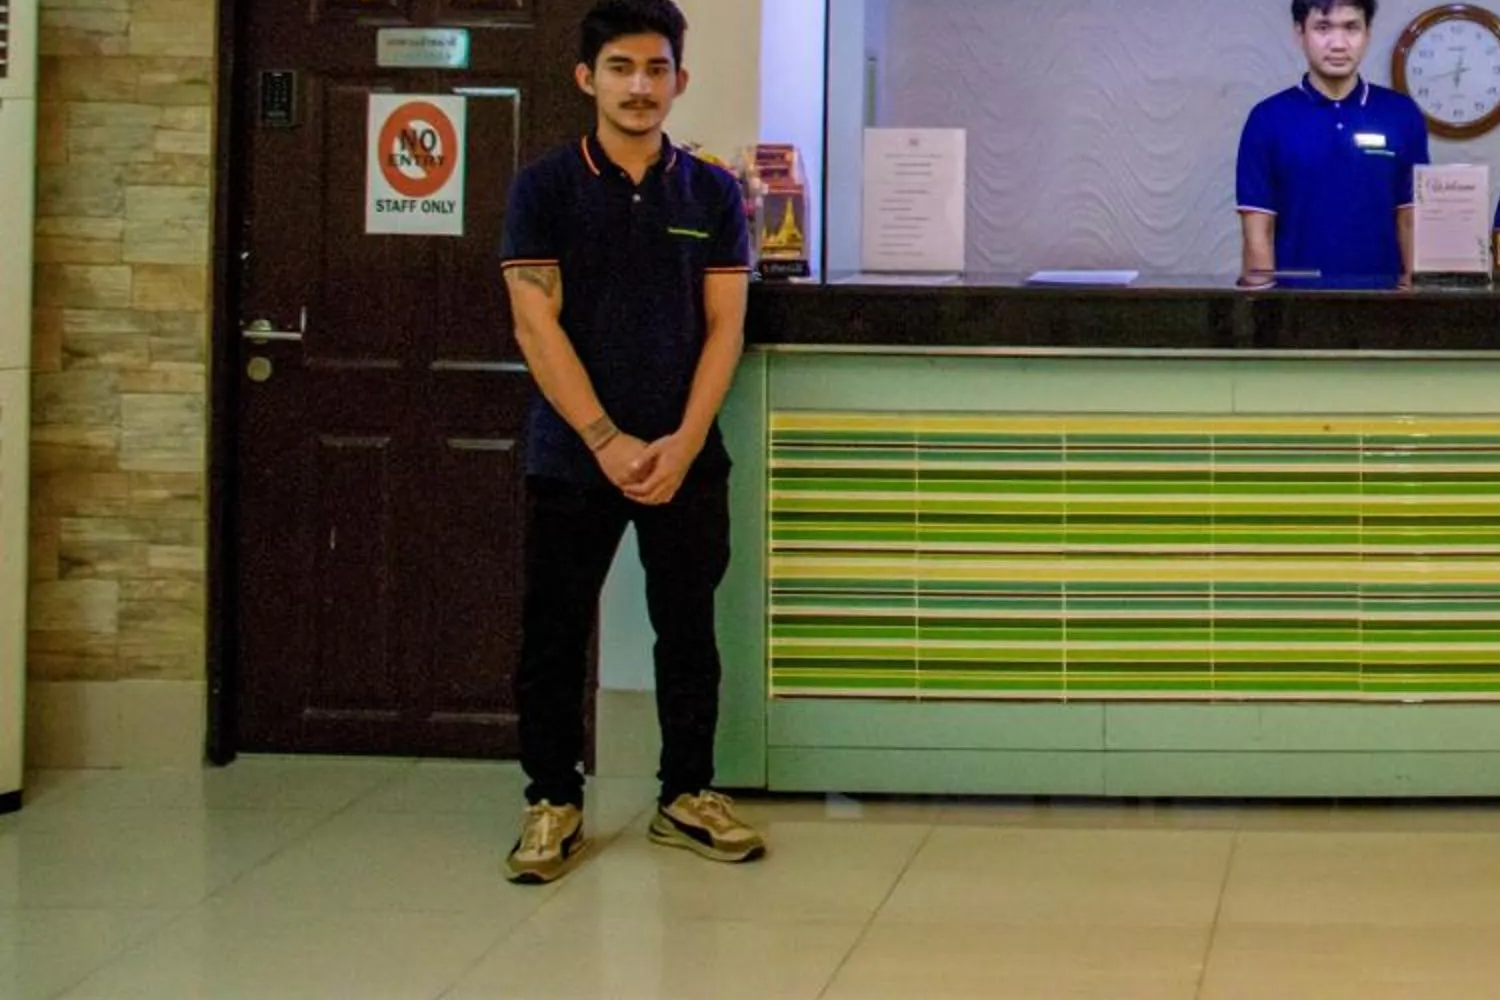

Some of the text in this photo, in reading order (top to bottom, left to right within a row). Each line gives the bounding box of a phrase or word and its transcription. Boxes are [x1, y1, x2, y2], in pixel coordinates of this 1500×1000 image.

[399, 128, 437, 152] NO
[375, 199, 456, 214] STAFF ONLY
